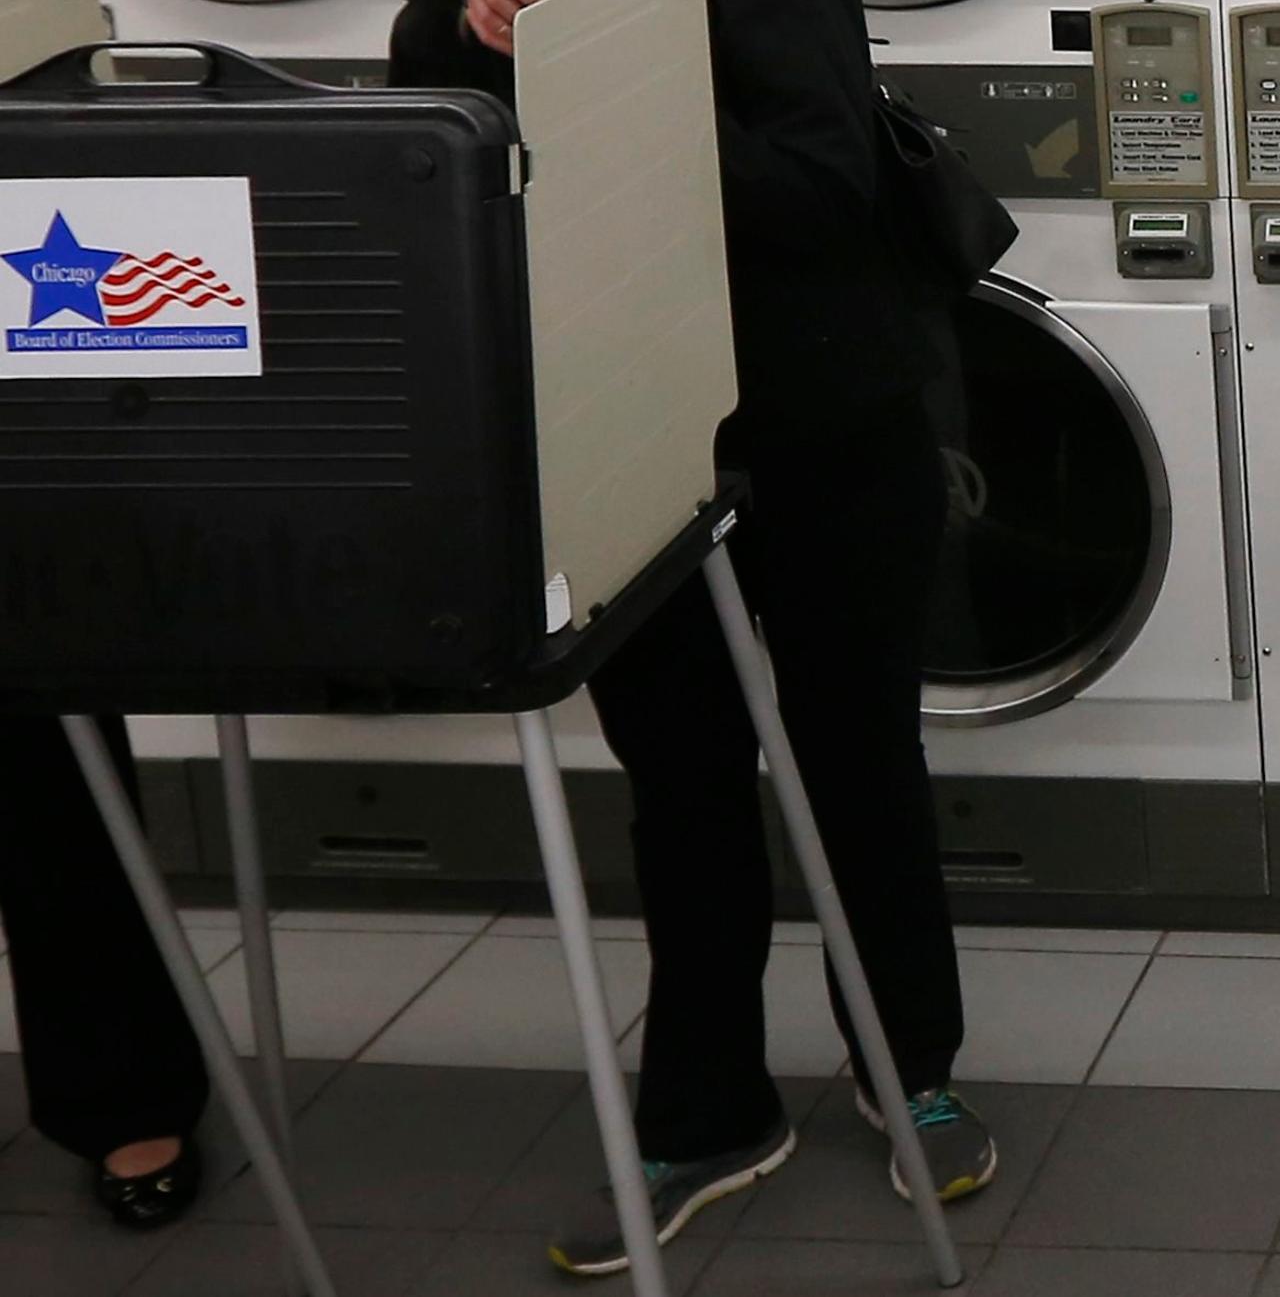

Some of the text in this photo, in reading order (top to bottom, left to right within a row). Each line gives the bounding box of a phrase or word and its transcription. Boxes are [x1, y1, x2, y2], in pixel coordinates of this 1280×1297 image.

[31, 262, 96, 286] Chicago
[14, 330, 240, 348] Board of Election Commissioners
